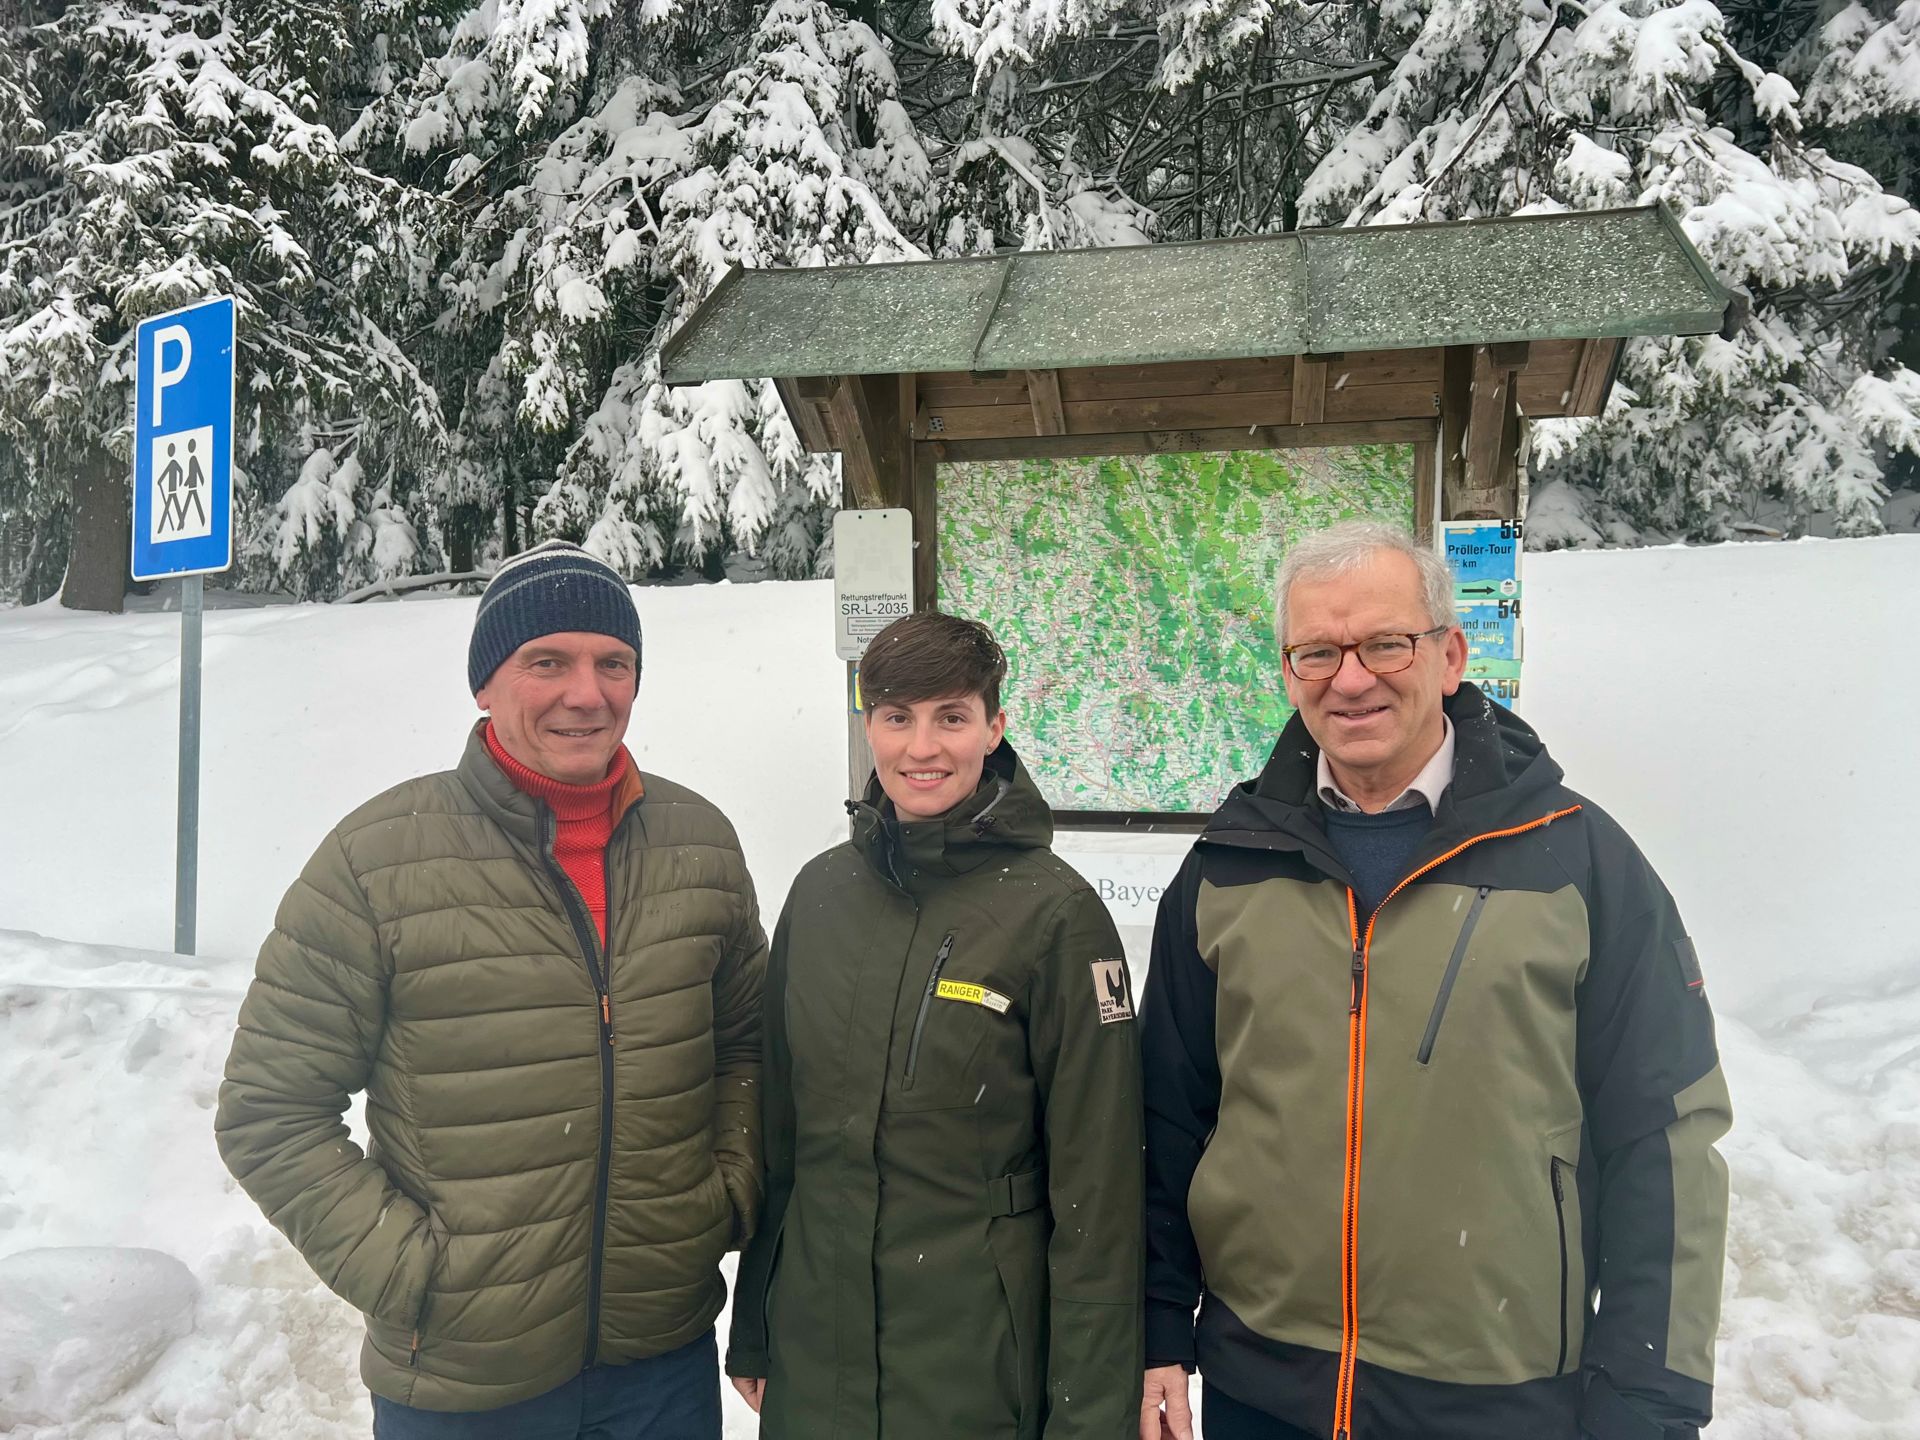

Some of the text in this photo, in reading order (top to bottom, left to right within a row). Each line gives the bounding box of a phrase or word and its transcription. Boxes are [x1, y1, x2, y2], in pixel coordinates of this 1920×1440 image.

[152, 324, 192, 428] P
[1500, 519, 1523, 539] 55
[1448, 544, 1512, 555] Pröller-Tour
[1462, 559, 1477, 568] km
[840, 593, 907, 602] Rettungstreffpunkt
[841, 603, 909, 615] SR-L-2035
[1498, 599, 1521, 619] 54
[1460, 619, 1499, 630] und um
[1497, 680, 1520, 699] 50
[1097, 878, 1166, 908] Baye
[939, 983, 981, 999] RANGER
